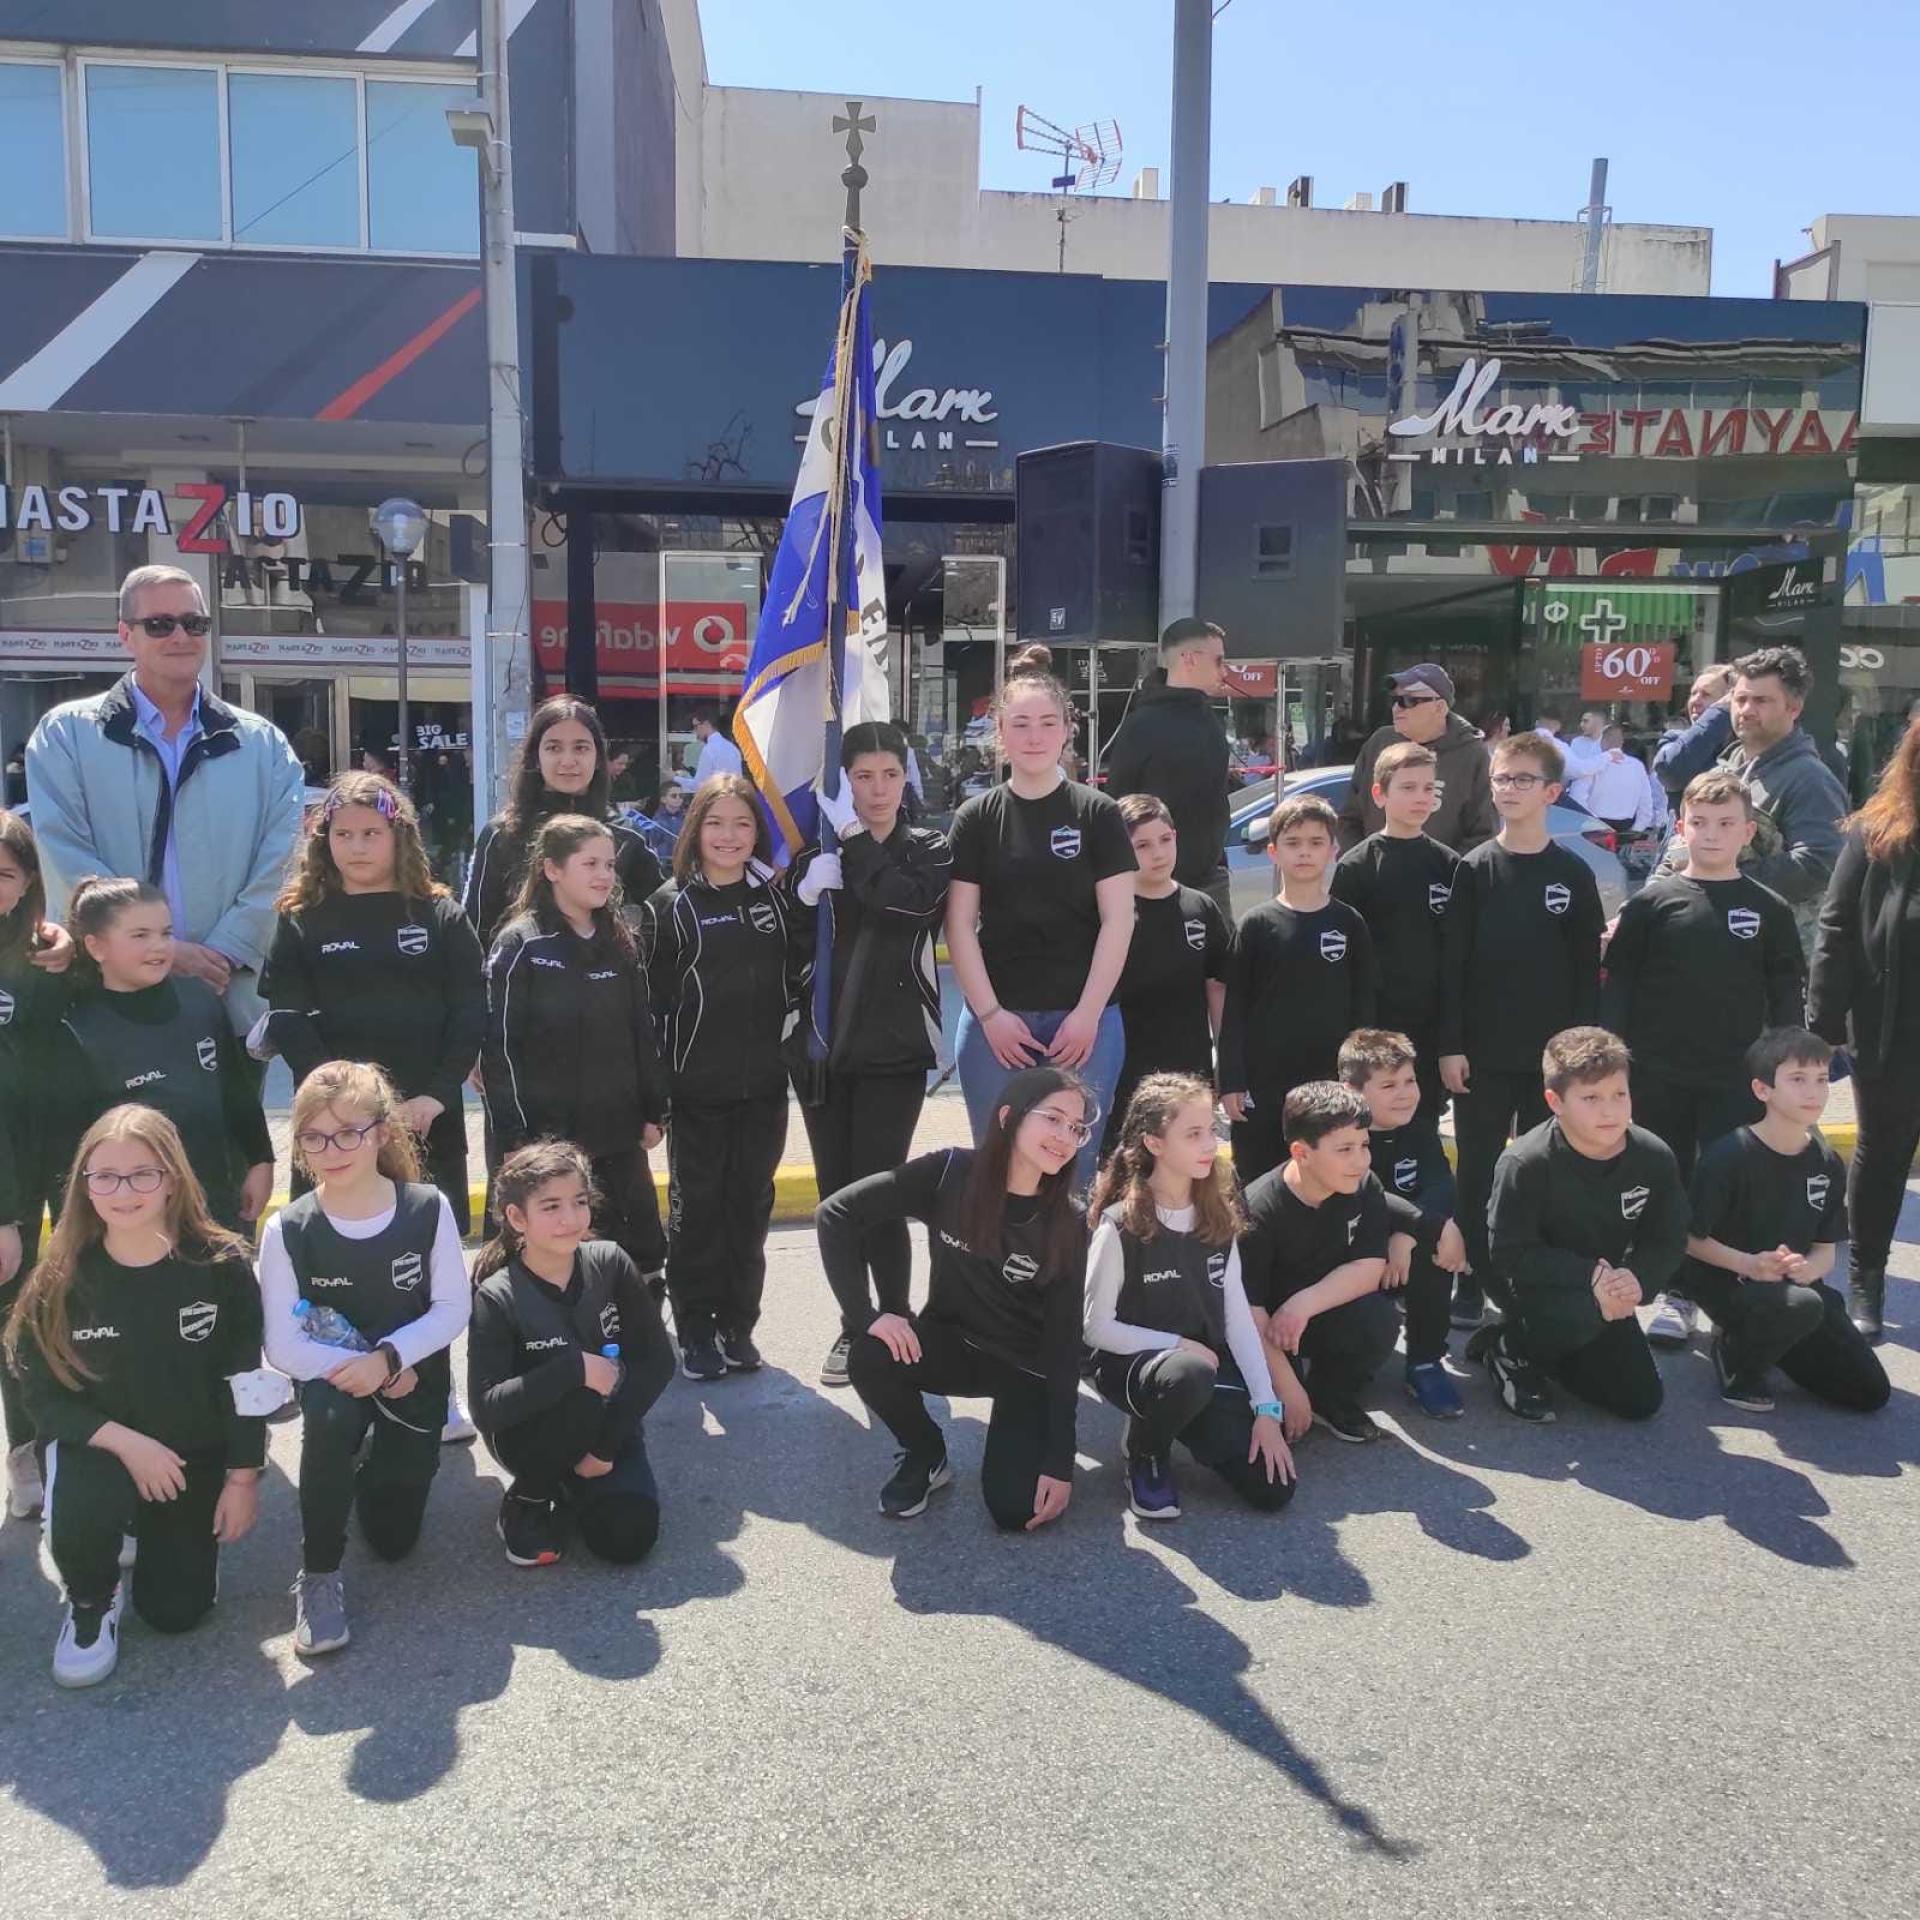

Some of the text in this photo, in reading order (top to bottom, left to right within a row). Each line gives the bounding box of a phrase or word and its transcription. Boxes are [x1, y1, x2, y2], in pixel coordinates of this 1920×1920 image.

[1388, 357, 1581, 438] Mark
[886, 429, 954, 450] LAN
[1431, 446, 1538, 465] MILAN
[1640, 676, 1661, 685] OFF
[415, 724, 442, 737] BIG
[418, 732, 468, 750] SALE
[321, 941, 361, 954] ROYAL
[125, 1069, 167, 1090] ROYAL
[311, 1276, 353, 1288] ROYAL
[1143, 1269, 1182, 1284] ROYAL
[72, 1326, 121, 1341] ROYAL
[525, 1336, 569, 1351] ROYAL
